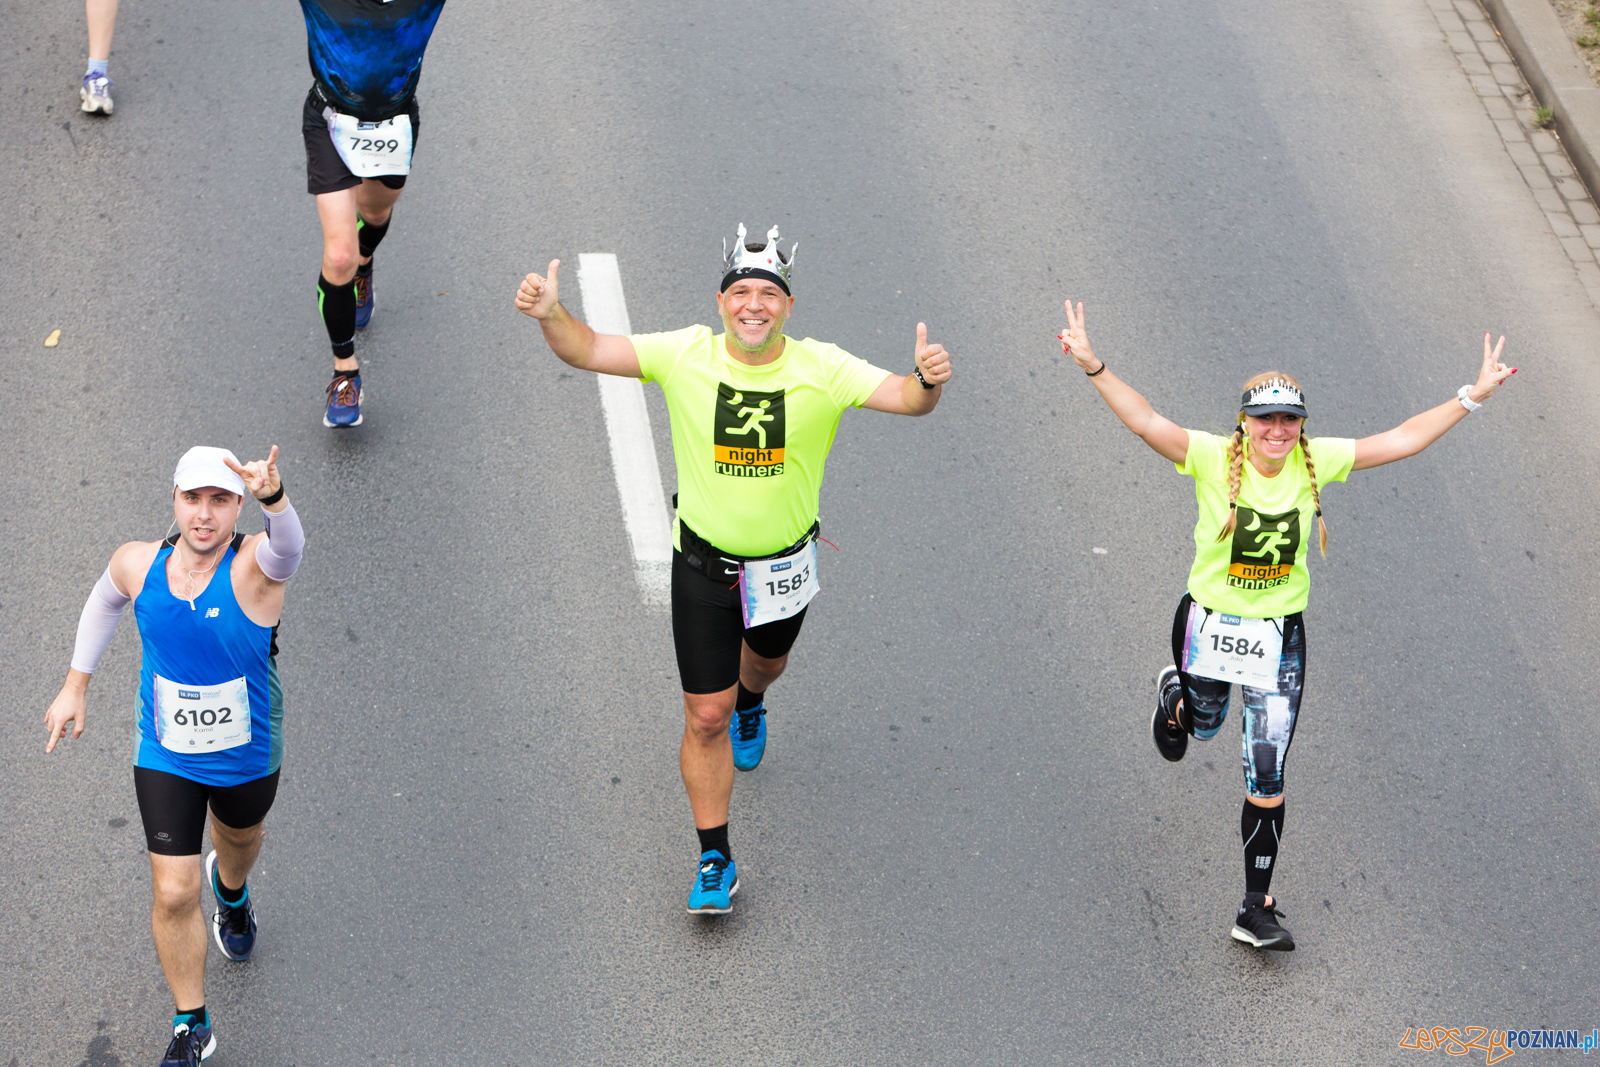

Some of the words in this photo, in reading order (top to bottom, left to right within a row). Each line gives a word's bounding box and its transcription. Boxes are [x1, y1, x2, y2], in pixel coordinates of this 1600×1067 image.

[350, 137, 399, 153] 7299
[729, 448, 773, 465] night
[715, 462, 784, 477] runners
[765, 564, 810, 596] 1583
[1242, 565, 1282, 580] night
[1227, 574, 1289, 590] runners
[1210, 634, 1265, 659] 1584
[173, 707, 233, 727] 6102
